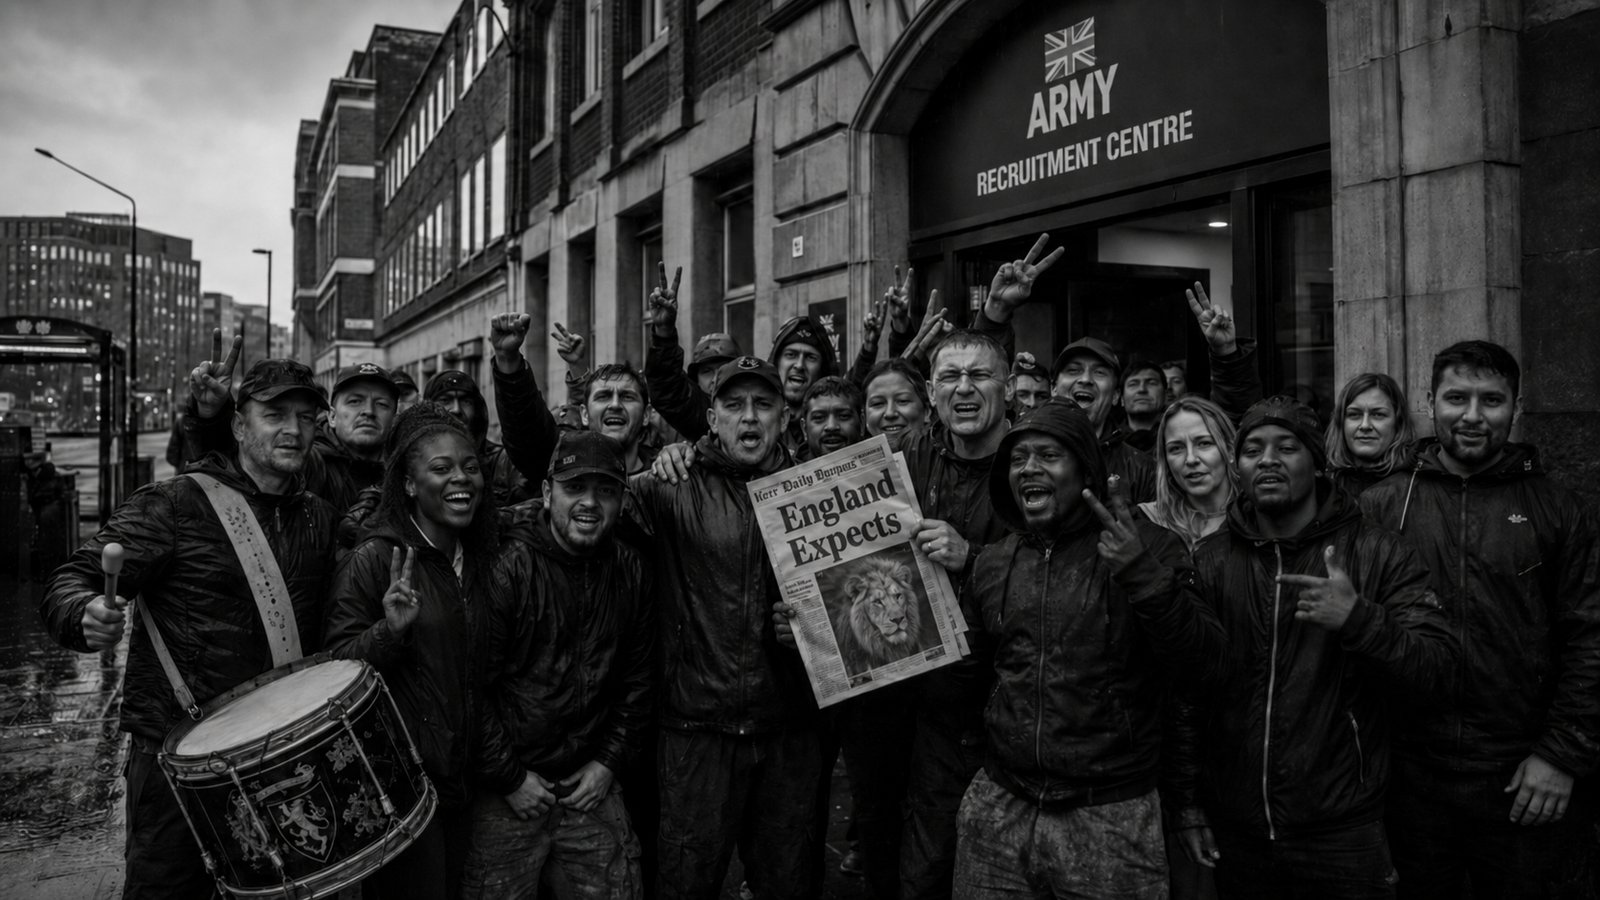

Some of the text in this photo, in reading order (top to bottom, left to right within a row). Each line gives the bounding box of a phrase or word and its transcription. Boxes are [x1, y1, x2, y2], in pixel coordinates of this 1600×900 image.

[1027, 63, 1119, 139] ARMY
[977, 109, 1193, 197] RECRUITMENT CENTRE
[777, 468, 898, 534] England
[781, 475, 814, 493] Daily
[786, 512, 902, 568] Expects
